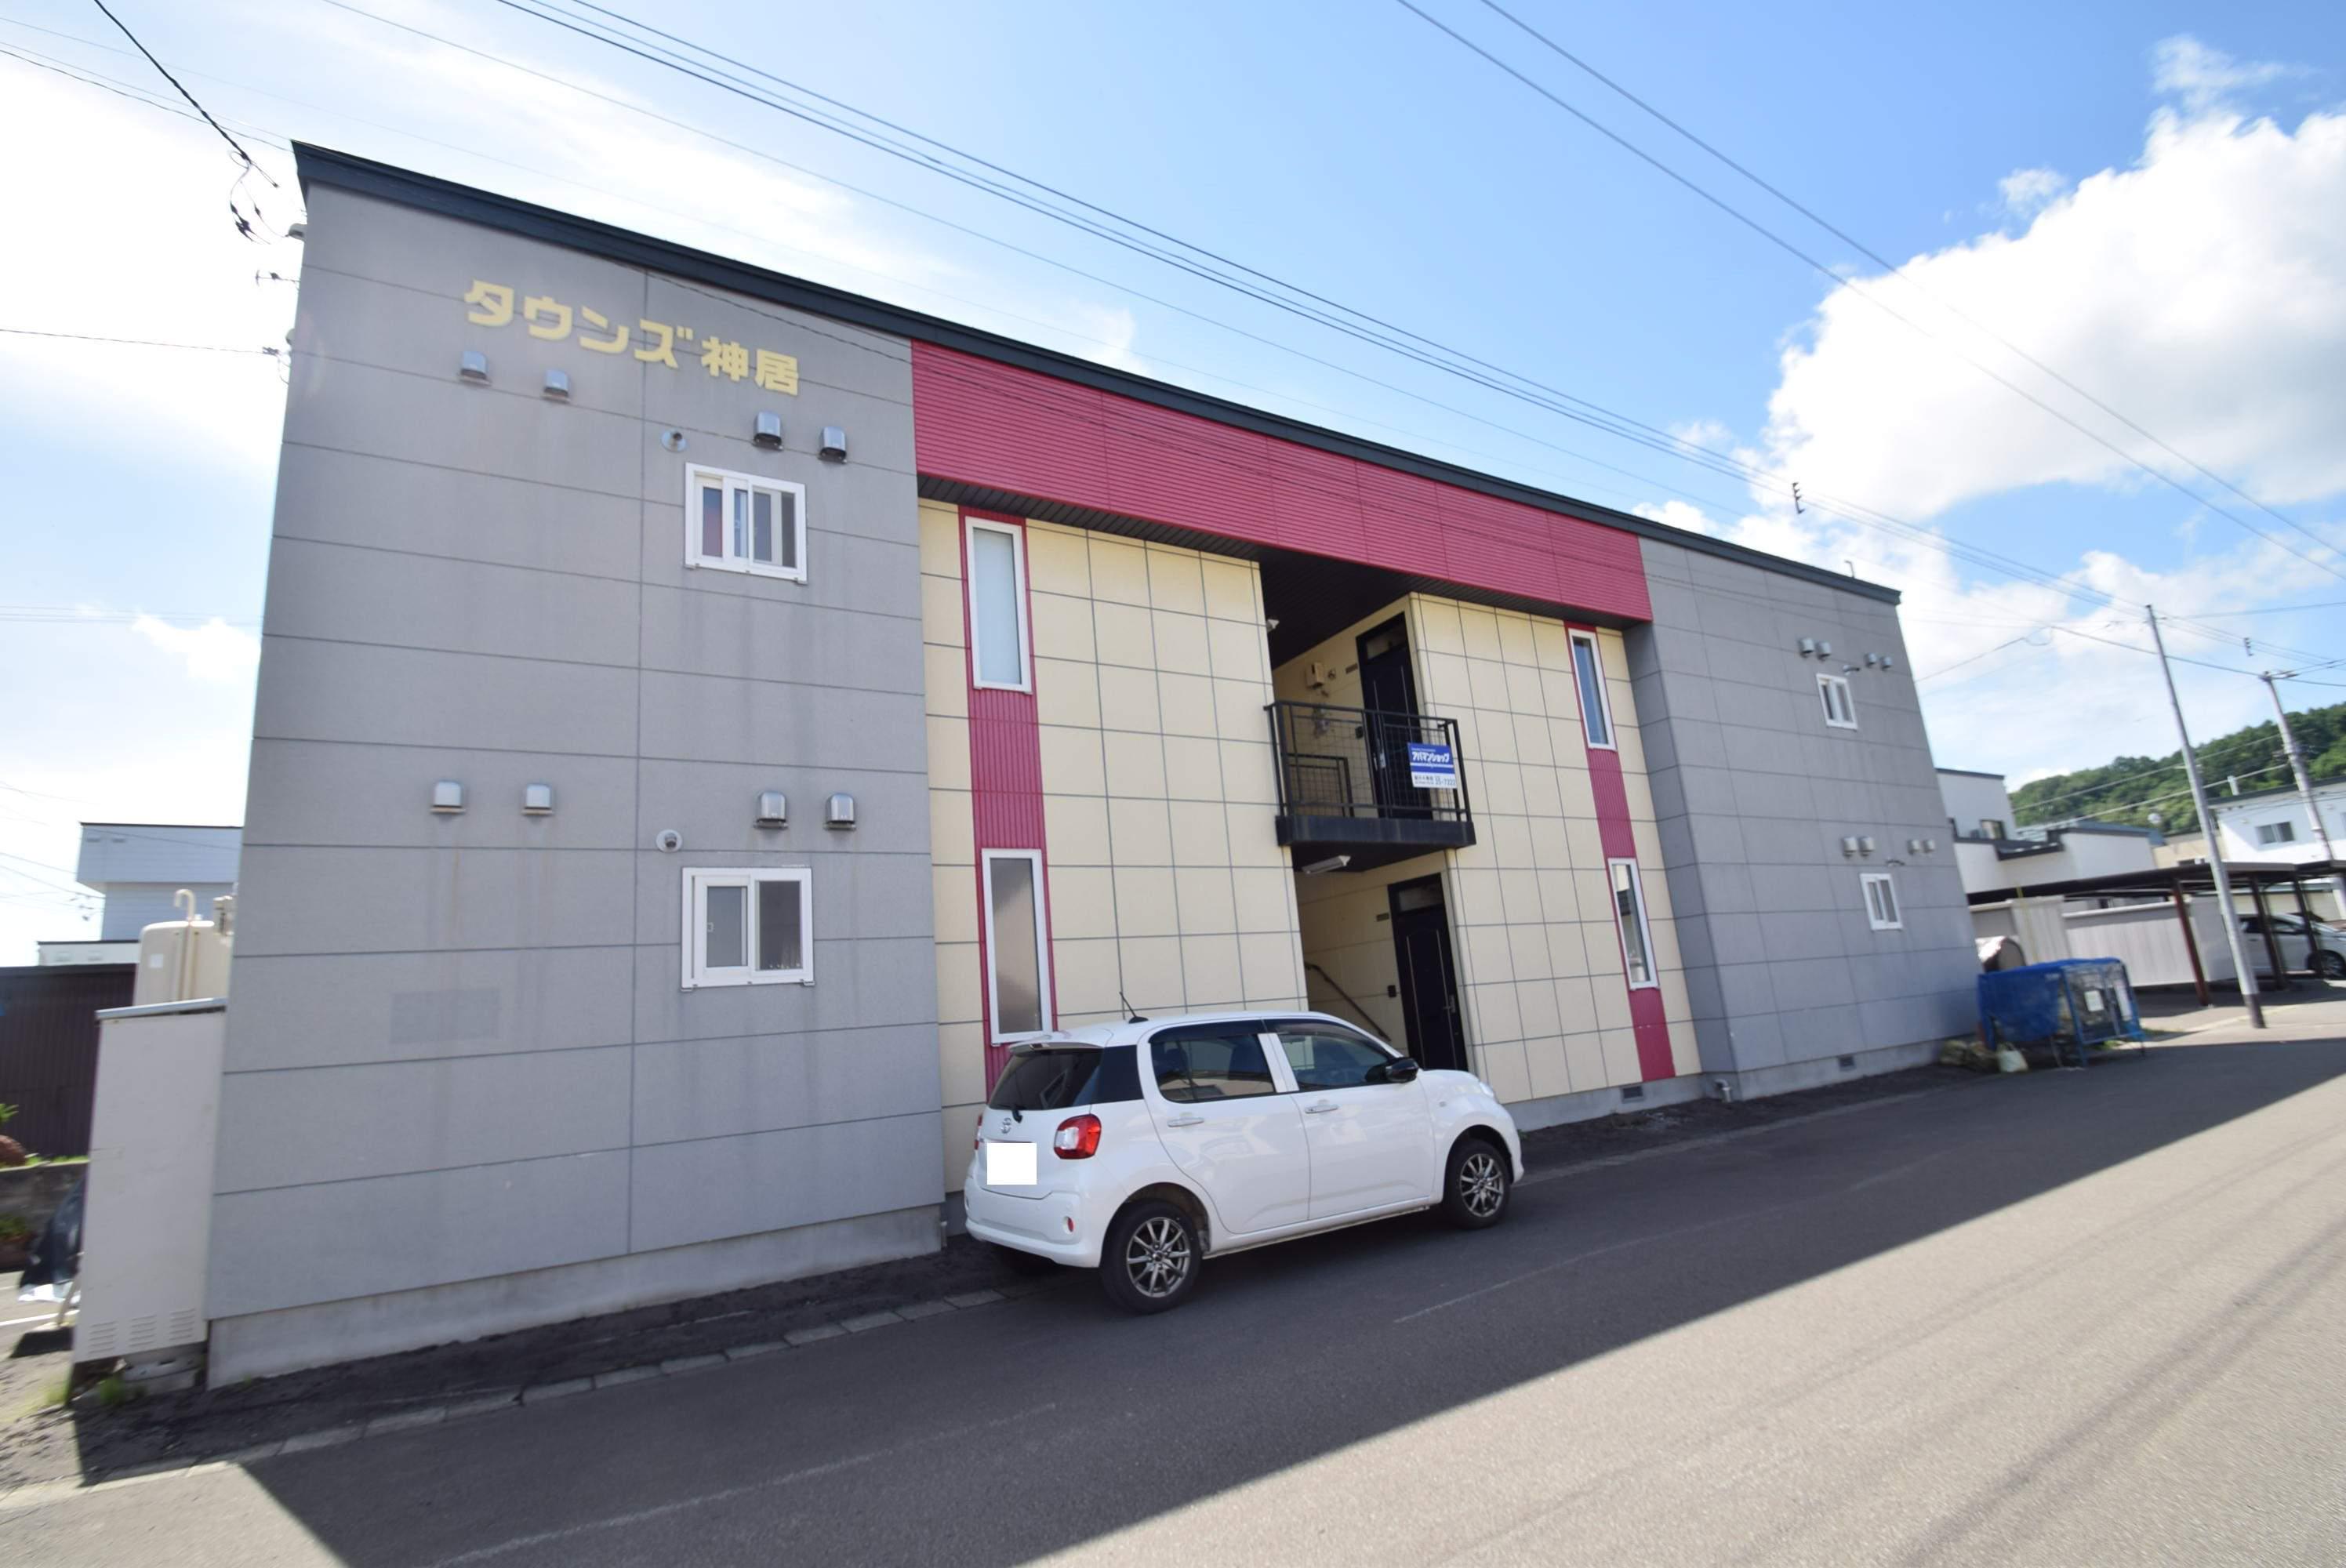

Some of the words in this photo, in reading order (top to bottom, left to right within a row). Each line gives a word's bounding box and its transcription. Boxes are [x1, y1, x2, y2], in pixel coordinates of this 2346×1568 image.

[464, 279, 799, 397] タウンズ神居
